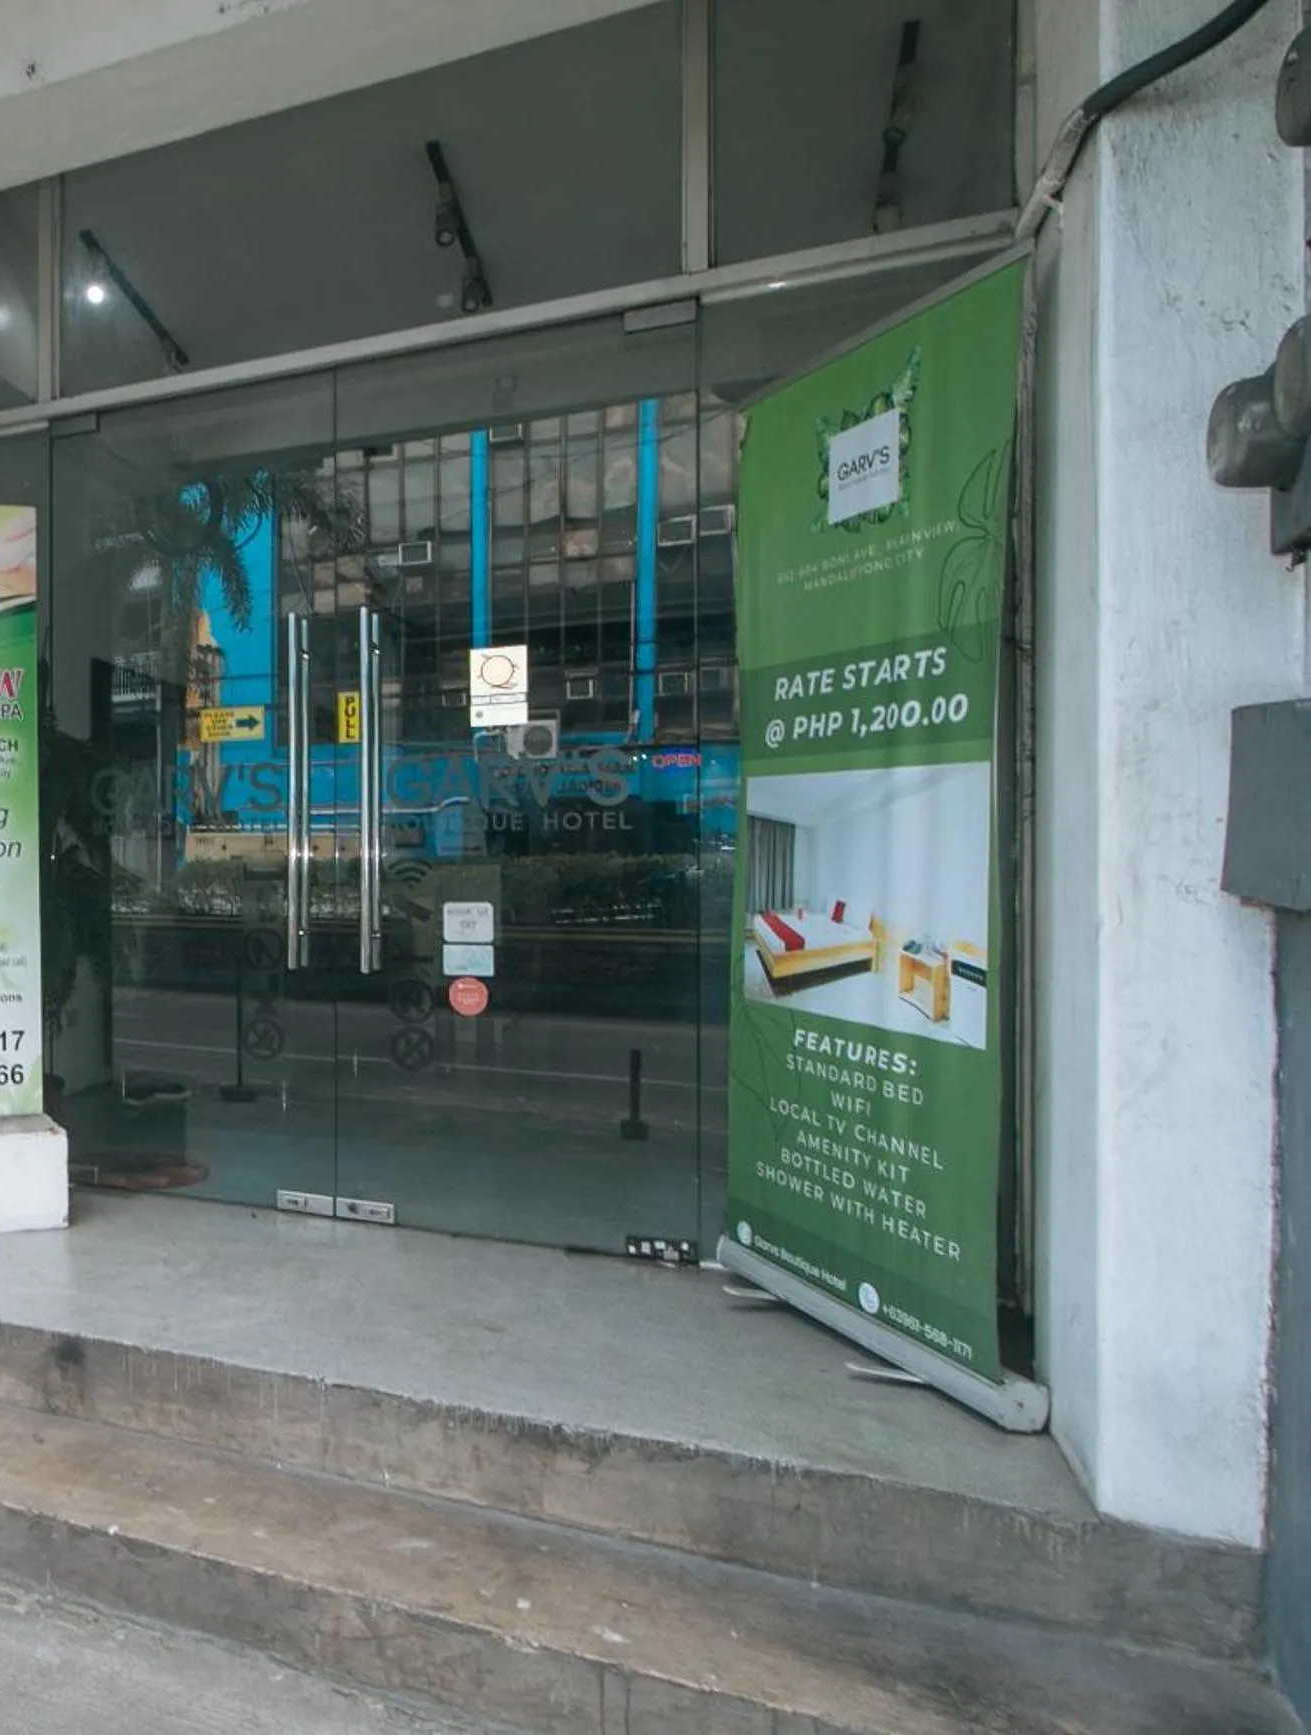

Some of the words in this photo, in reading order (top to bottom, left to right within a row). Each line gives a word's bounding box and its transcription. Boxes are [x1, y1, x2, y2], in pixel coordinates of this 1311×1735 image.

[837, 445, 890, 481] GARV'S
[775, 667, 834, 702] RATE
[841, 646, 947, 690] STARTS
[344, 696, 356, 739] PULL
[765, 722, 785, 749] @
[792, 713, 842, 741] PHP
[850, 693, 969, 737] 1,200.00
[389, 750, 633, 812] GARV'S
[652, 754, 701, 768] OPEN
[542, 811, 633, 831] HOTEL
[794, 1029, 918, 1076] FEATURES:
[785, 1054, 878, 1094] STANDARD
[882, 1078, 925, 1107] BED
[830, 1090, 871, 1117] WIFI
[770, 1096, 821, 1128] LOCAL
[827, 1114, 847, 1135] TV
[854, 1124, 944, 1171] CHANNEL
[796, 1130, 872, 1166] AMENITY
[877, 1160, 910, 1184] KIT
[780, 1148, 856, 1190] BOTTLED
[862, 1178, 928, 1220] WATER
[756, 1162, 824, 1202] SHOWER
[831, 1193, 875, 1224] WITH
[881, 1213, 962, 1262] HEATER
